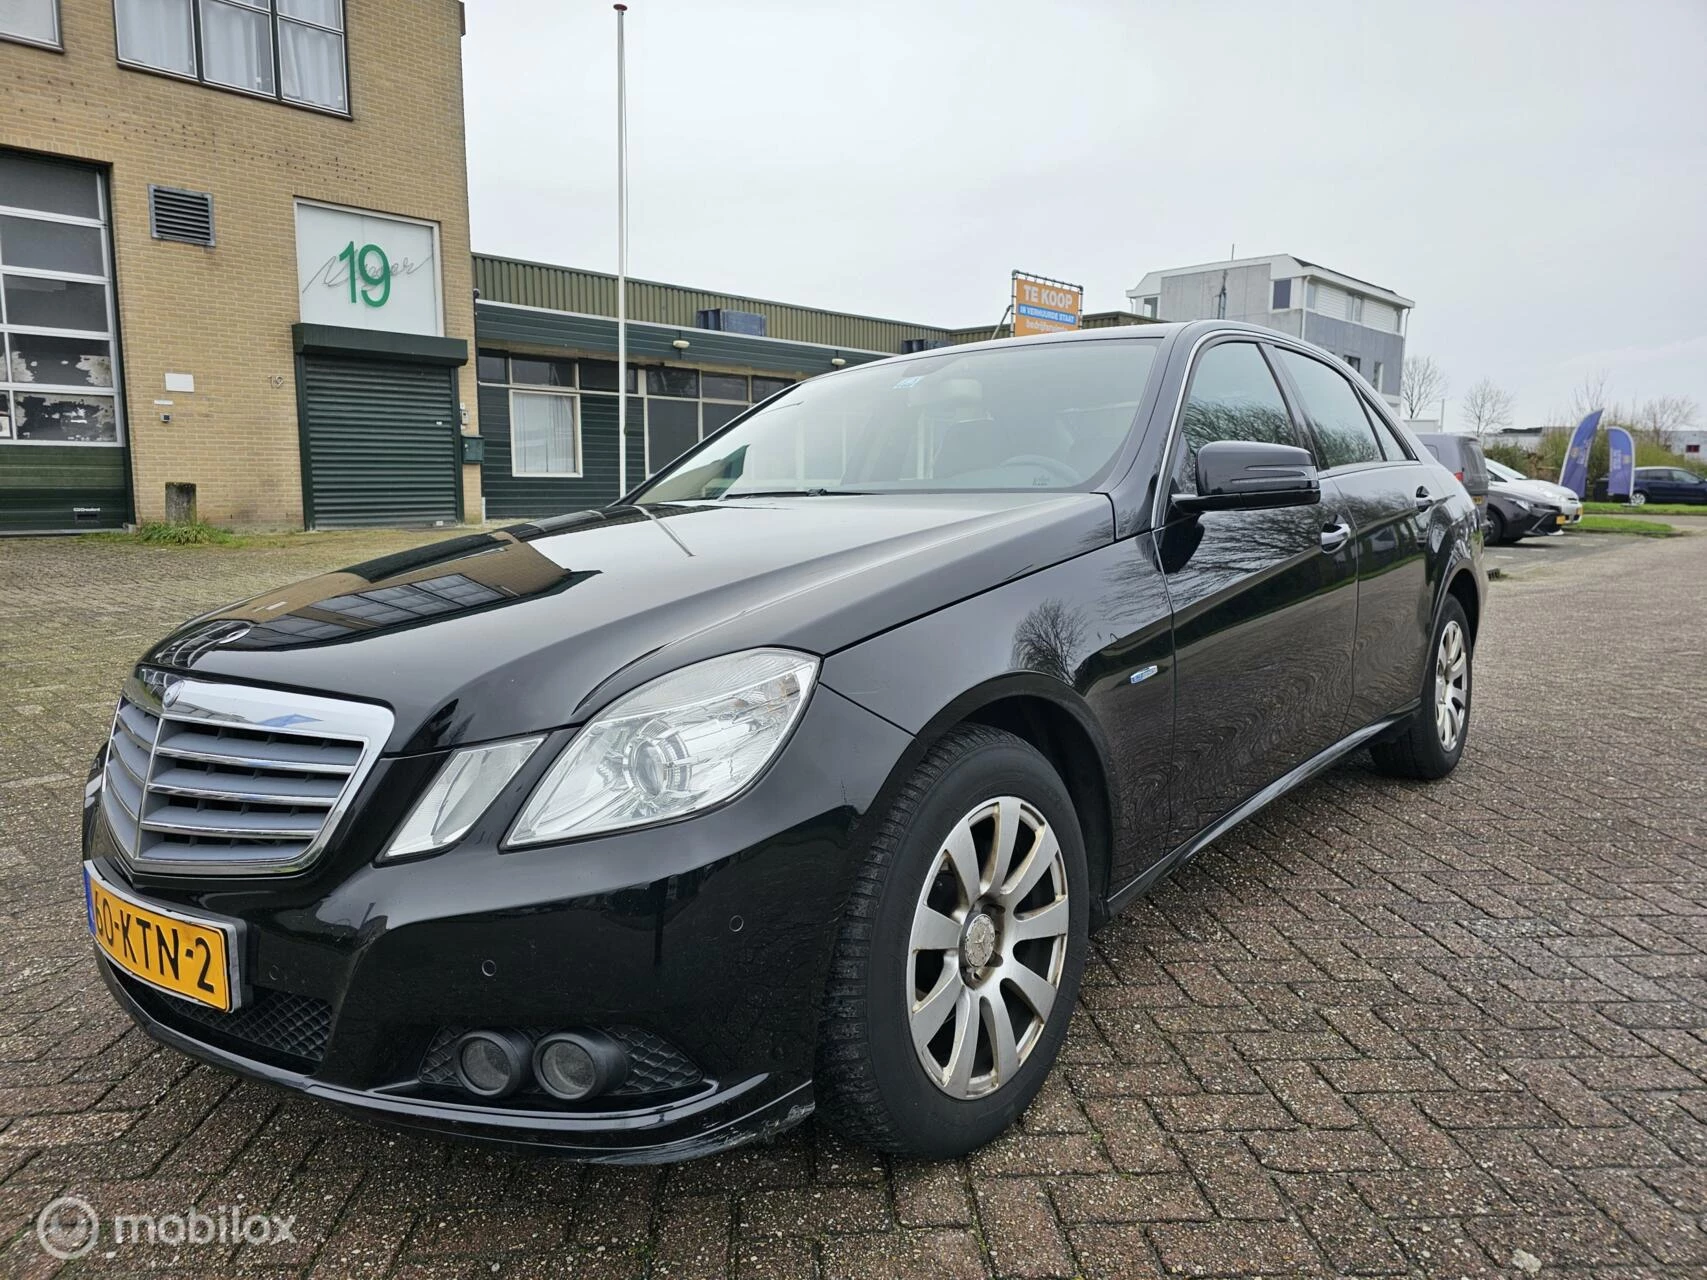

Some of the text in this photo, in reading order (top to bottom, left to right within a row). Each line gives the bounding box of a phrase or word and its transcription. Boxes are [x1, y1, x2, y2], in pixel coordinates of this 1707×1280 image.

[339, 240, 391, 308] 19
[1023, 284, 1073, 309] TE KOOP
[95, 890, 215, 994] 60-KTN-2
